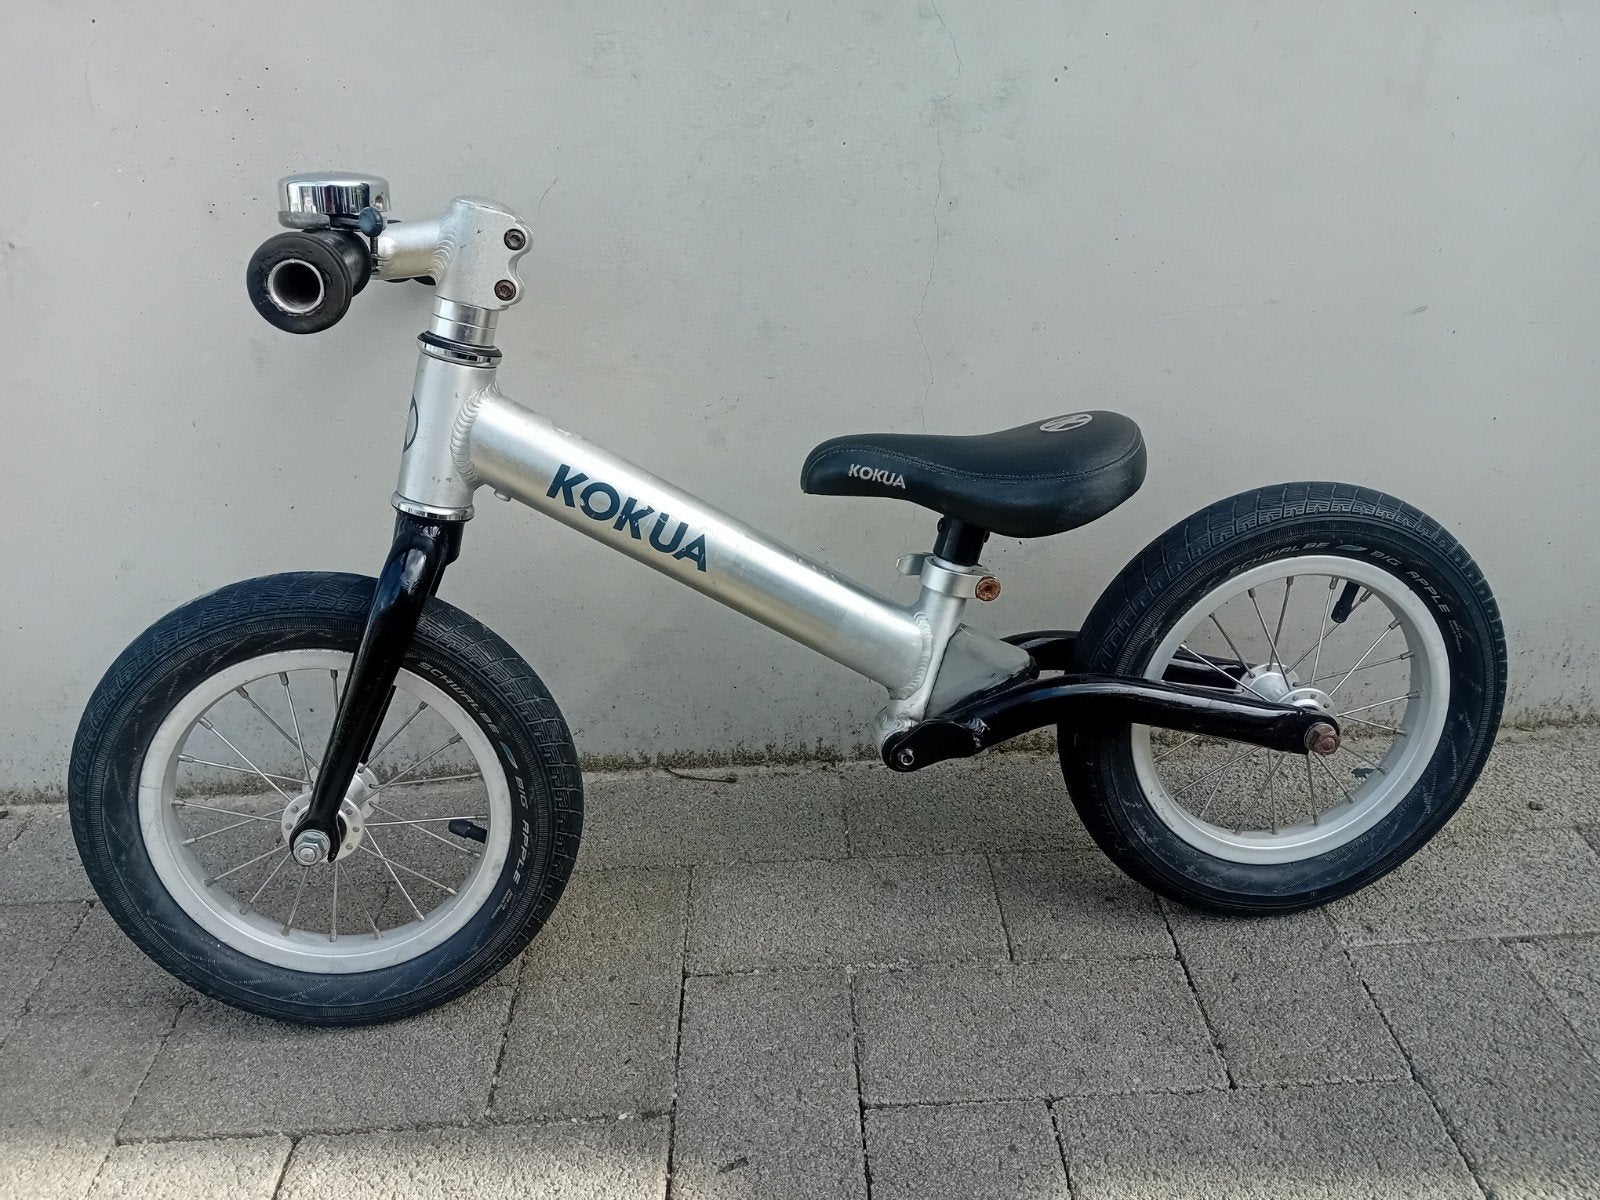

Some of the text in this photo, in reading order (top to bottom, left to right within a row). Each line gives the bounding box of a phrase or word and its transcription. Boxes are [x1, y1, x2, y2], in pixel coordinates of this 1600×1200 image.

[546, 463, 707, 572] KOKUA
[848, 463, 906, 489] KOKUA
[1369, 550, 1402, 566] BIG
[1406, 570, 1451, 613] APPLE
[417, 661, 530, 885] SCHWALBE BIG APPLE
